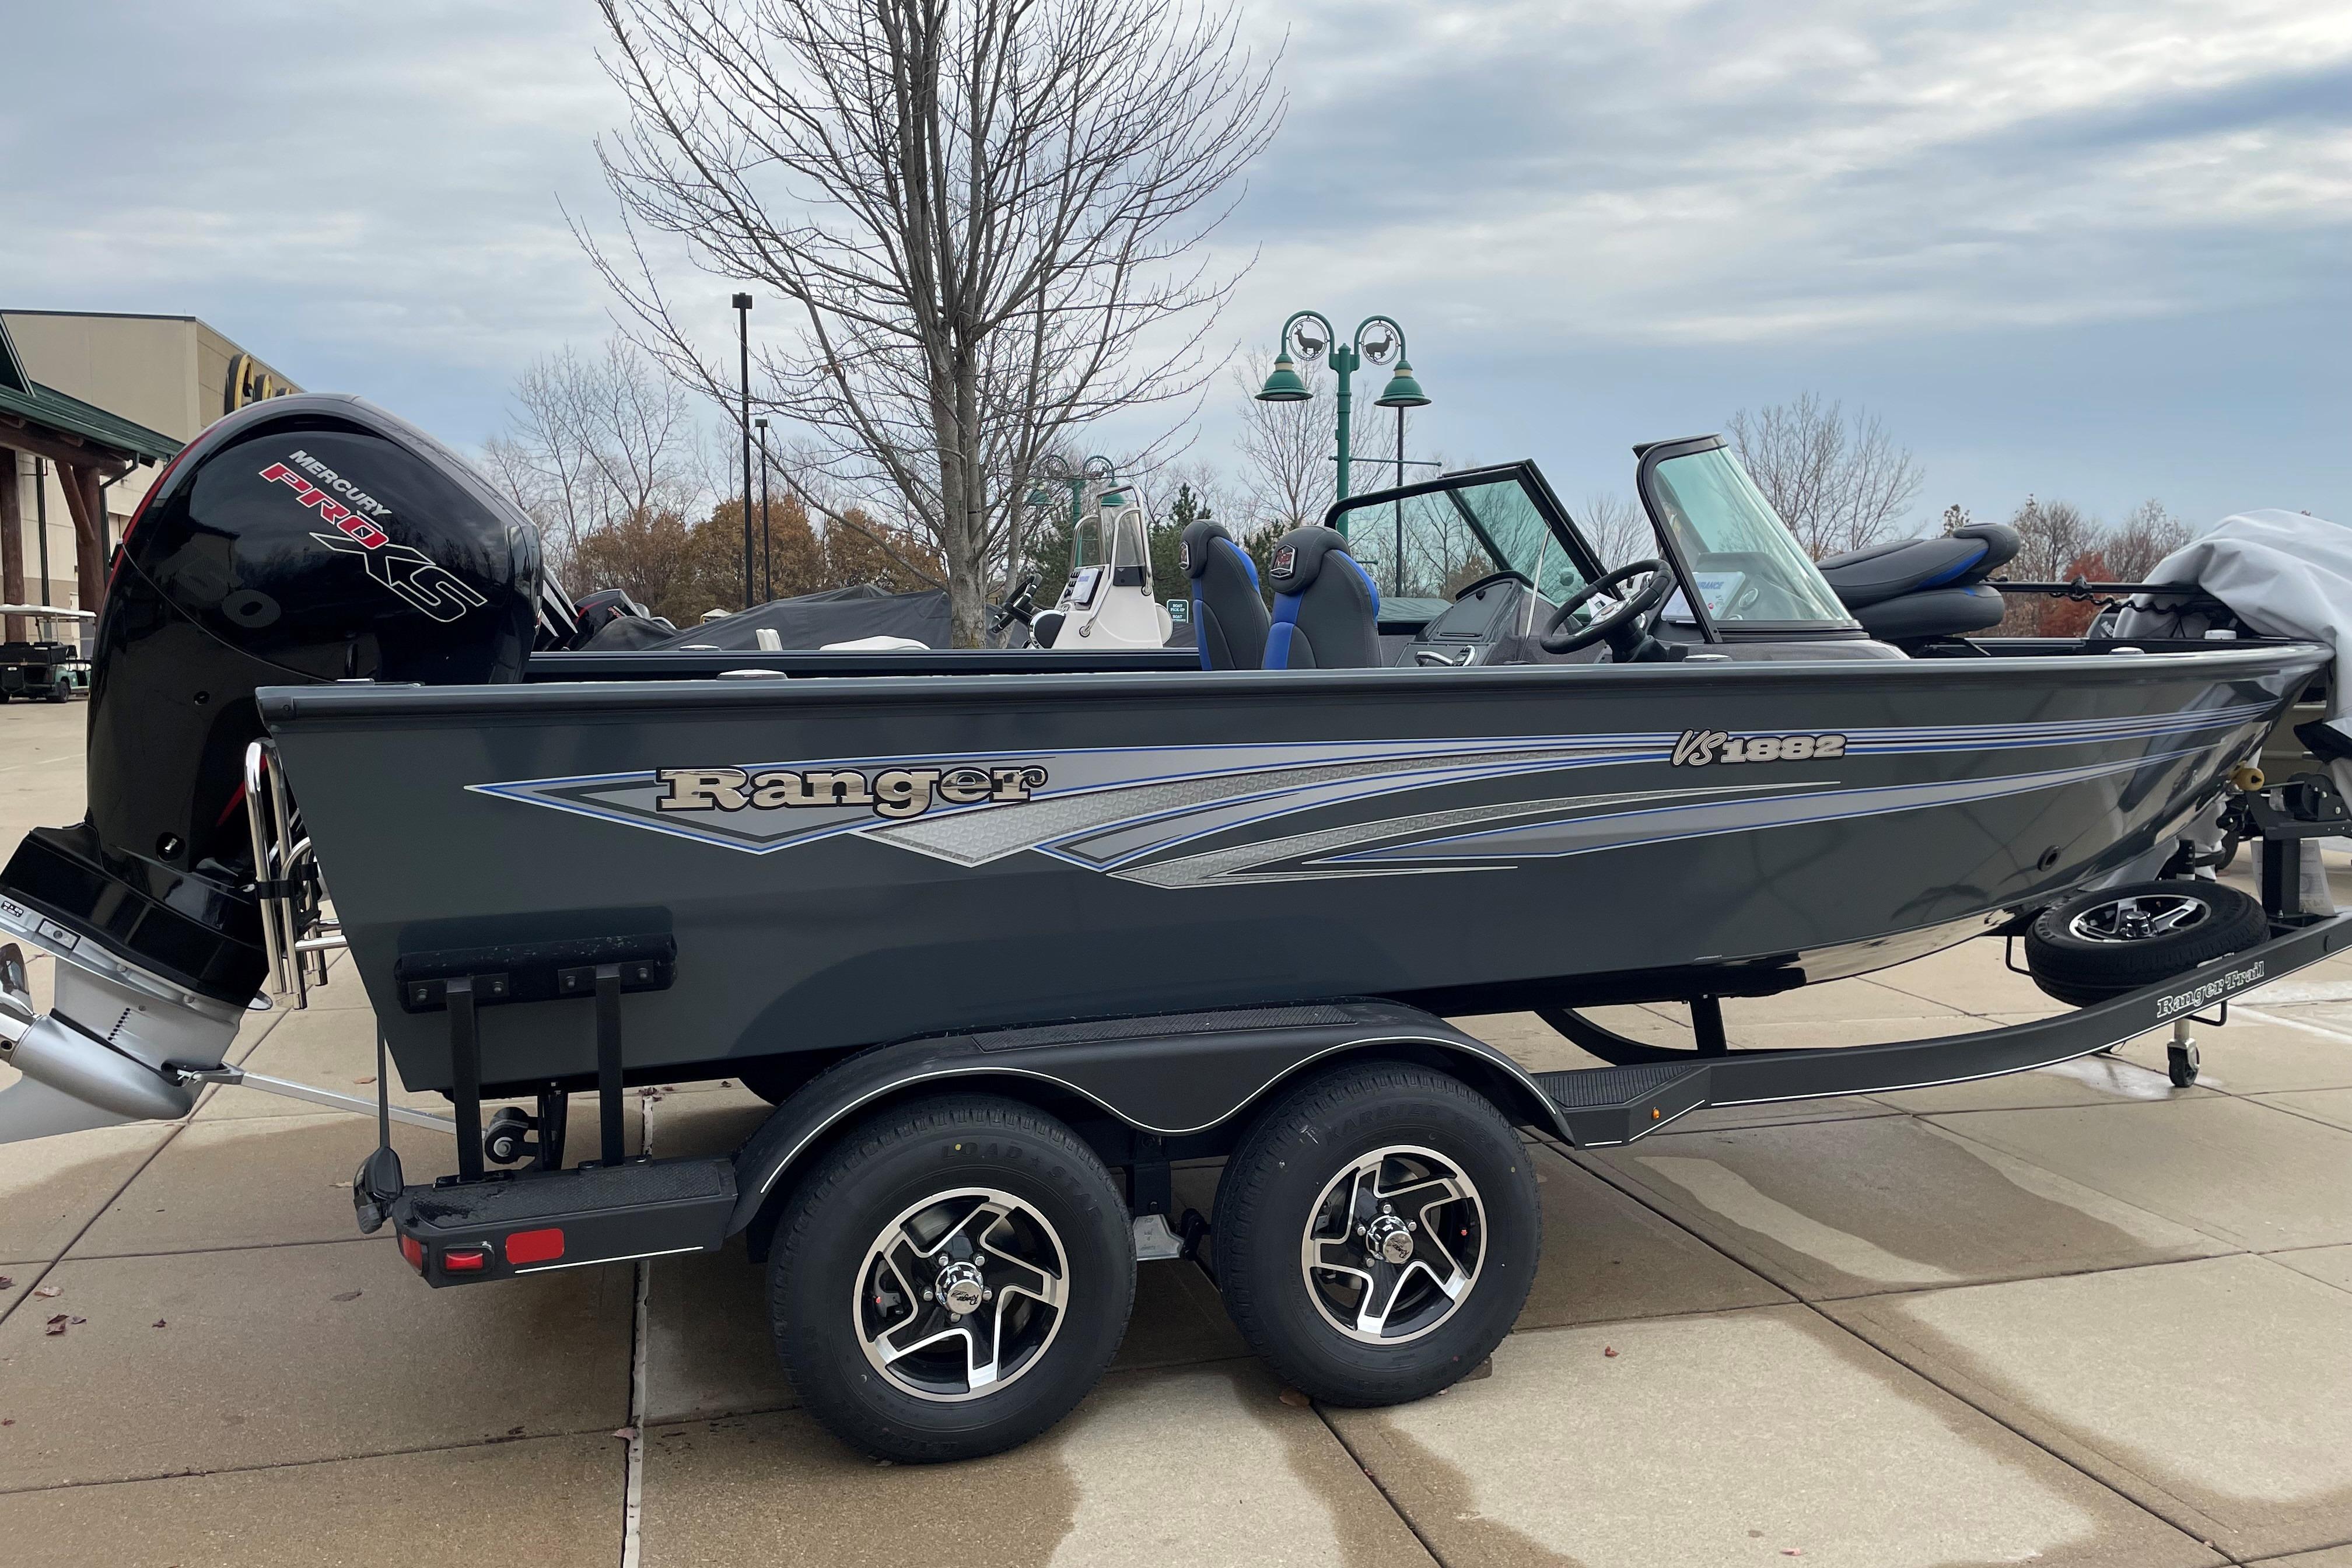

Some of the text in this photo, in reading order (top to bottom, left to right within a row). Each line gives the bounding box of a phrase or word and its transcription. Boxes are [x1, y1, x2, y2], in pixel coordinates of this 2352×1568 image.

[288, 449, 393, 516] MERCURY
[258, 461, 488, 623] PRO XS
[657, 766, 1048, 818] Ranger
[2157, 960, 2264, 1019] Ranger Trail
[941, 1142, 1023, 1160] LOAD
[1324, 1102, 1441, 1146] KARRIER
